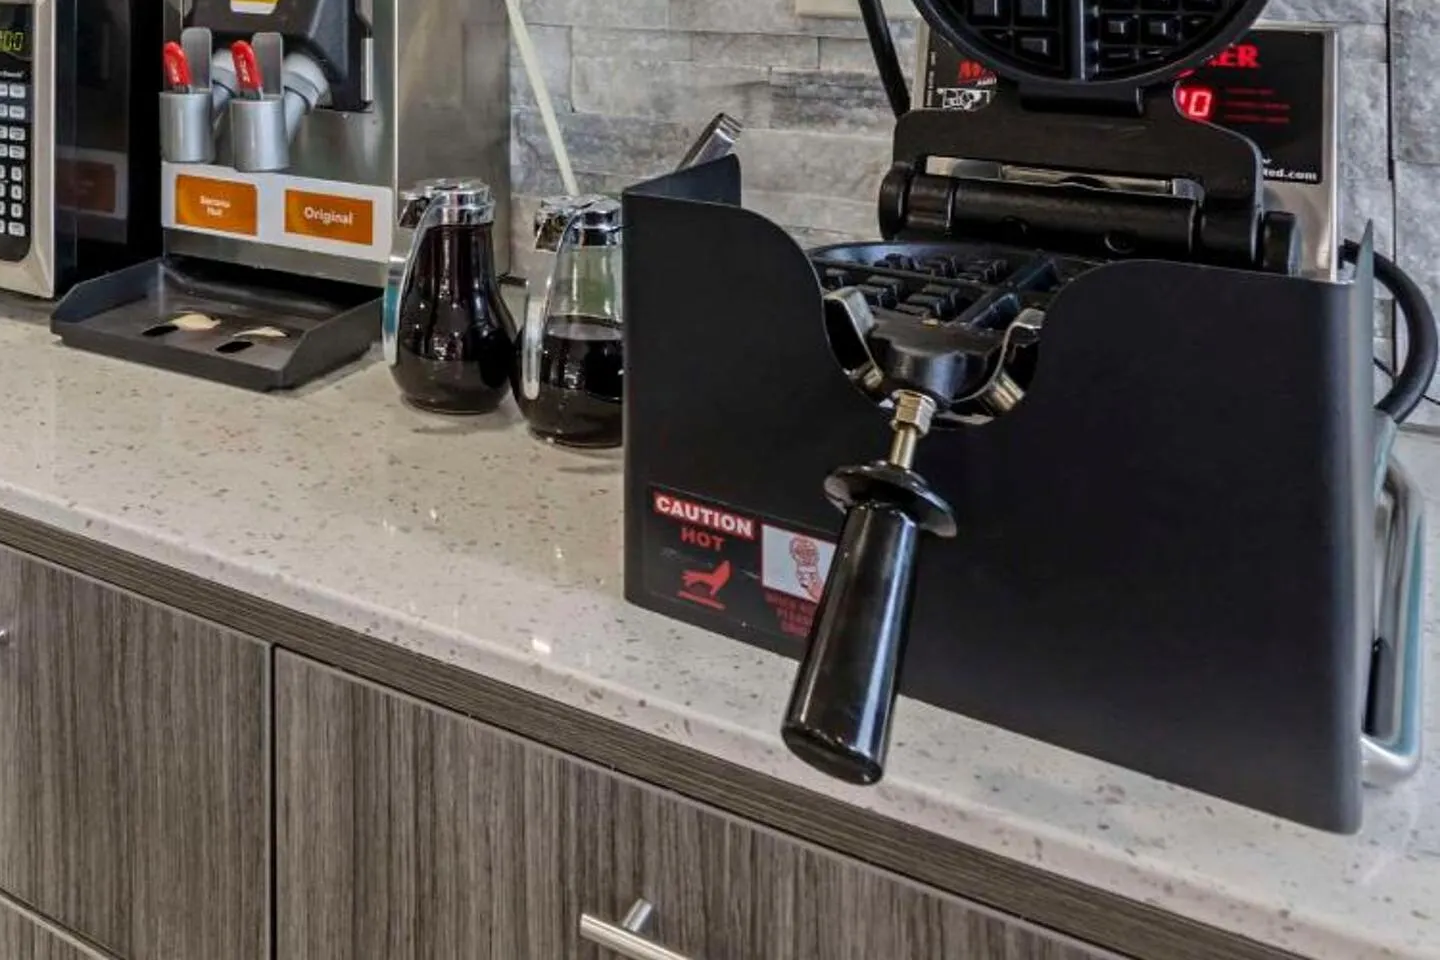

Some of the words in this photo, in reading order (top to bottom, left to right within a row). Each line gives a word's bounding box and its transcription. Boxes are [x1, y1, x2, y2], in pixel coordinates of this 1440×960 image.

[304, 206, 353, 226] Original
[655, 495, 754, 537] CAUTION
[679, 527, 725, 551] HOT
